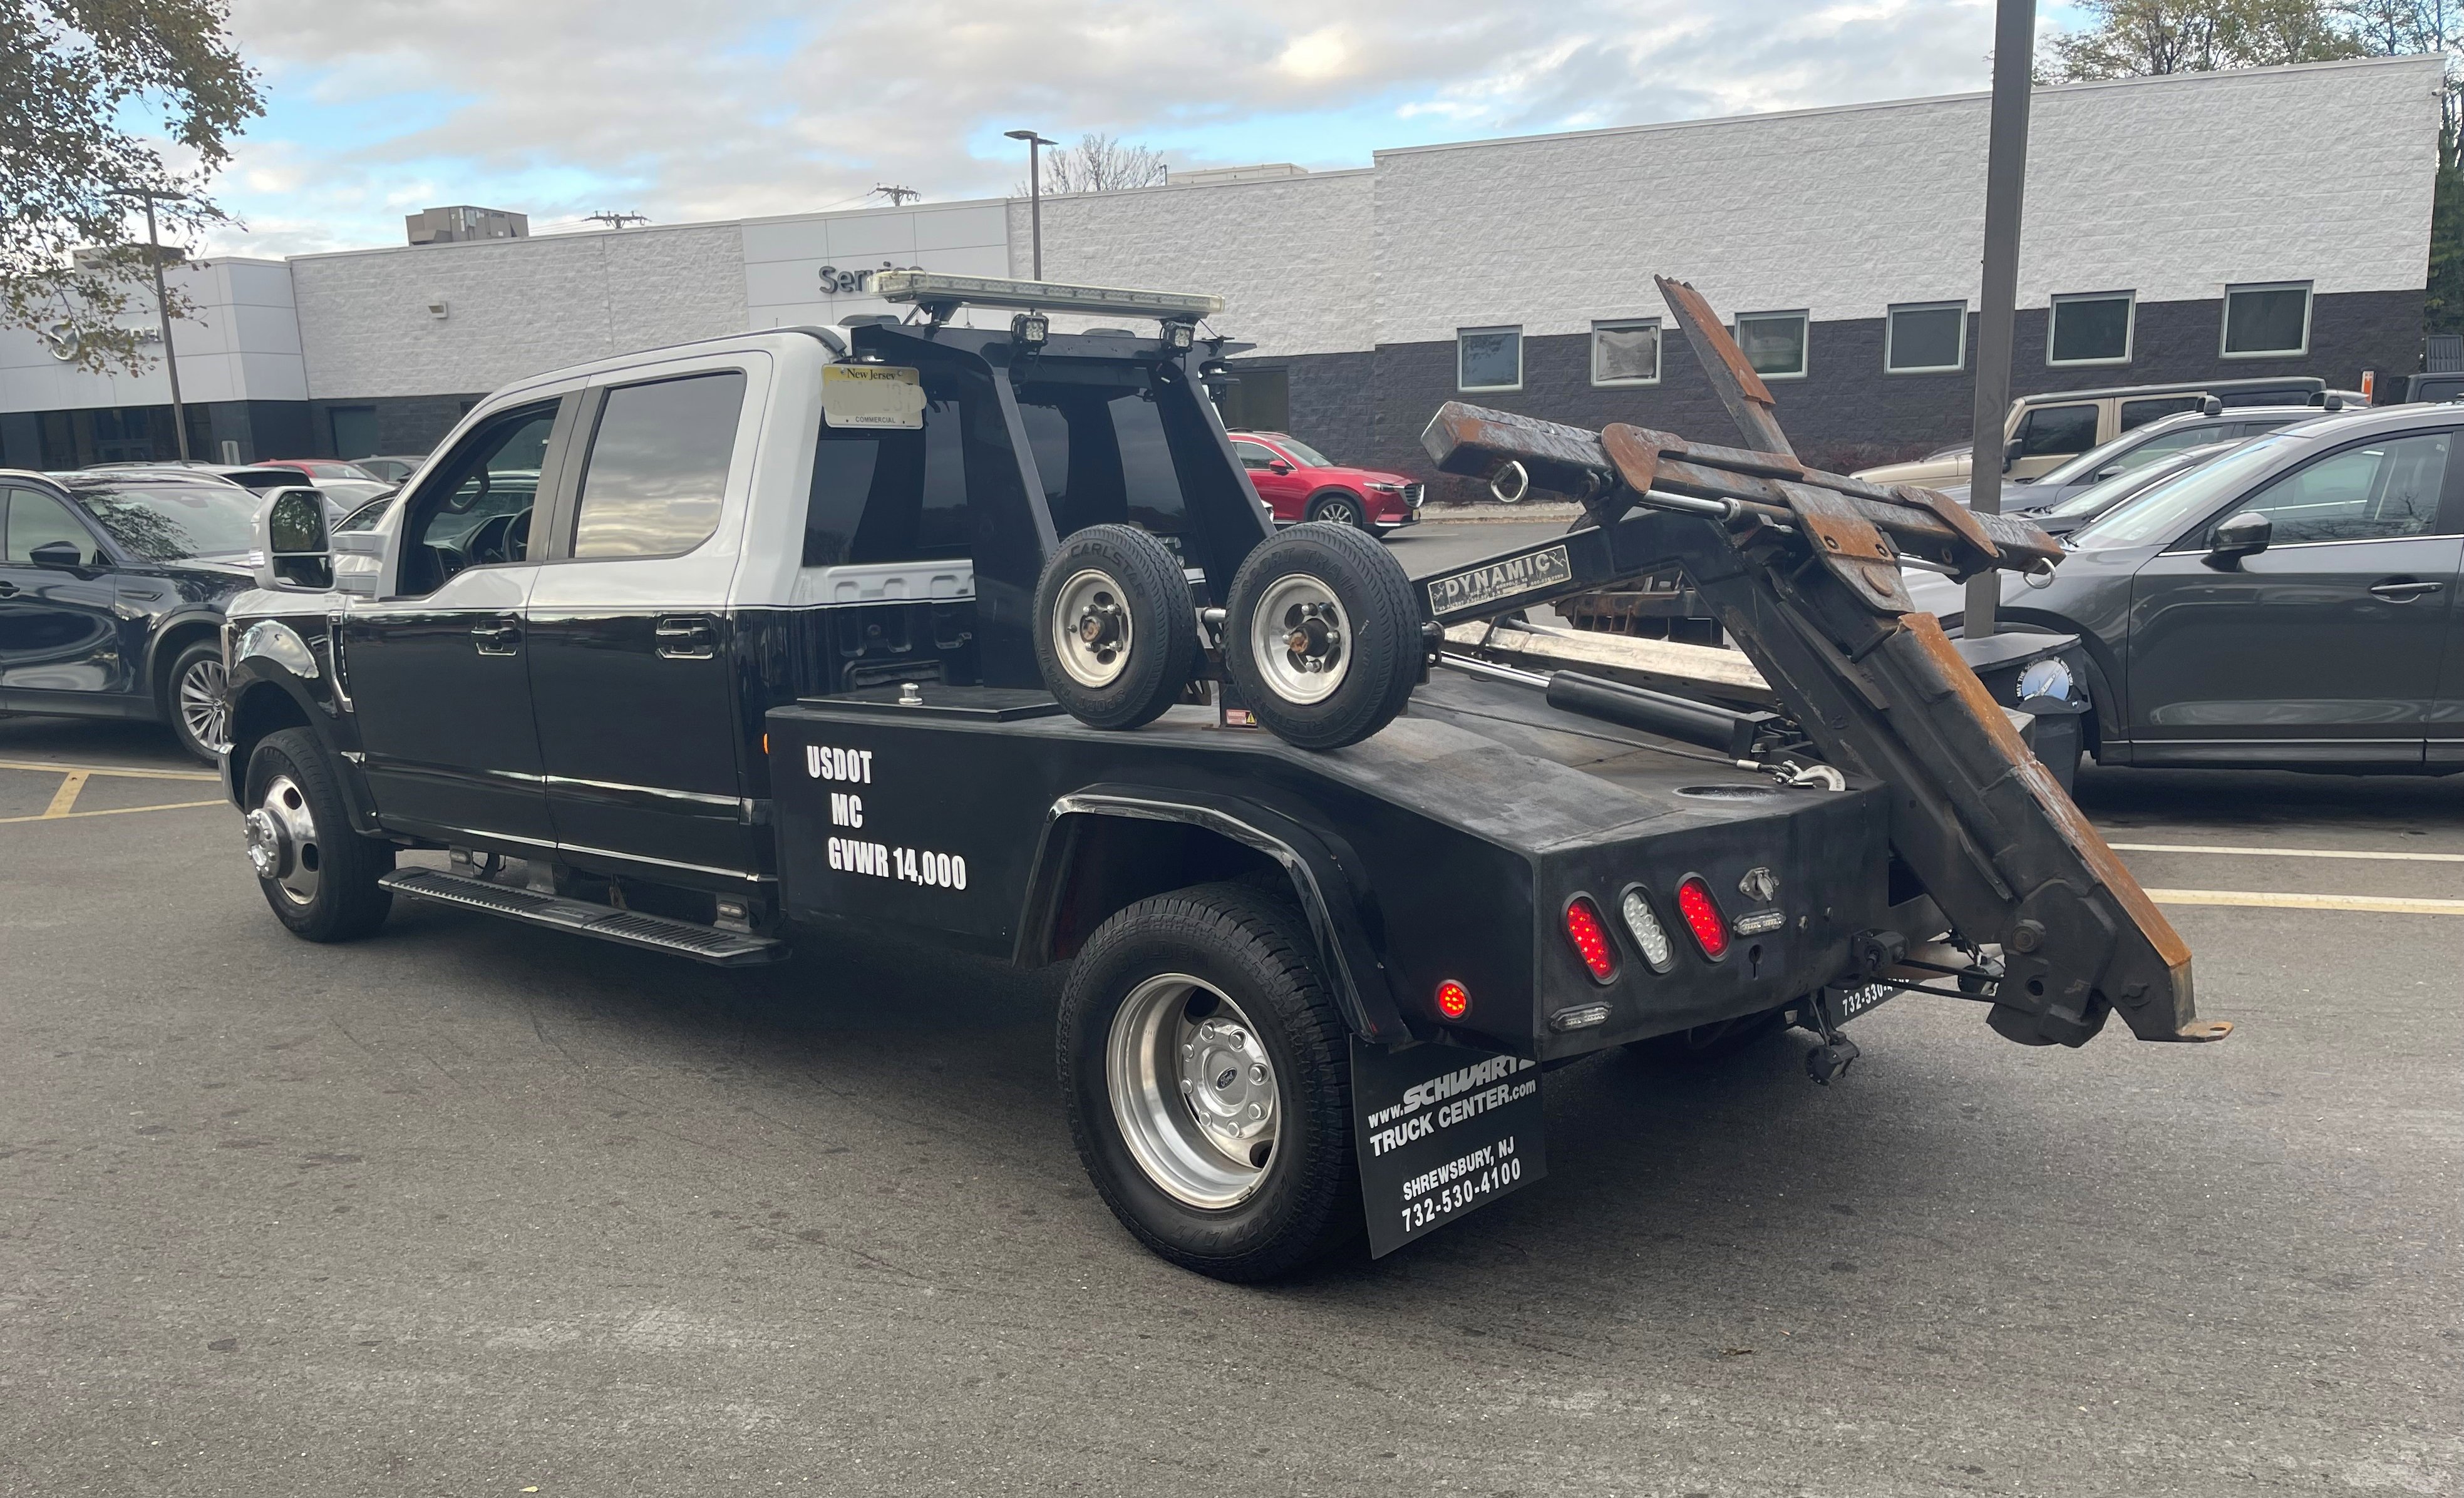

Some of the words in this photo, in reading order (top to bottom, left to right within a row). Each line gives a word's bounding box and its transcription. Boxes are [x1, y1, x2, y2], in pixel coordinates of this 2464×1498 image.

[847, 368, 867, 379] New
[869, 369, 896, 380] Jersey
[855, 416, 896, 424] COMMERCIAL
[1070, 542, 1145, 600] CARLSTAR
[1445, 553, 1550, 597] DYNAMIC
[807, 745, 872, 784] USDOT
[831, 793, 863, 828] MC
[828, 837, 889, 878] GVWR
[892, 847, 967, 890] 14,000
[1842, 978, 1909, 1016] 732-530-
[1370, 1112, 1434, 1157] TRUCK
[1438, 1079, 1537, 1128] CENTER.com
[1403, 1146, 1495, 1201] SHREWSBURY,
[1498, 1136, 1515, 1159] NJ
[1401, 1158, 1521, 1232] 732-530-4100
